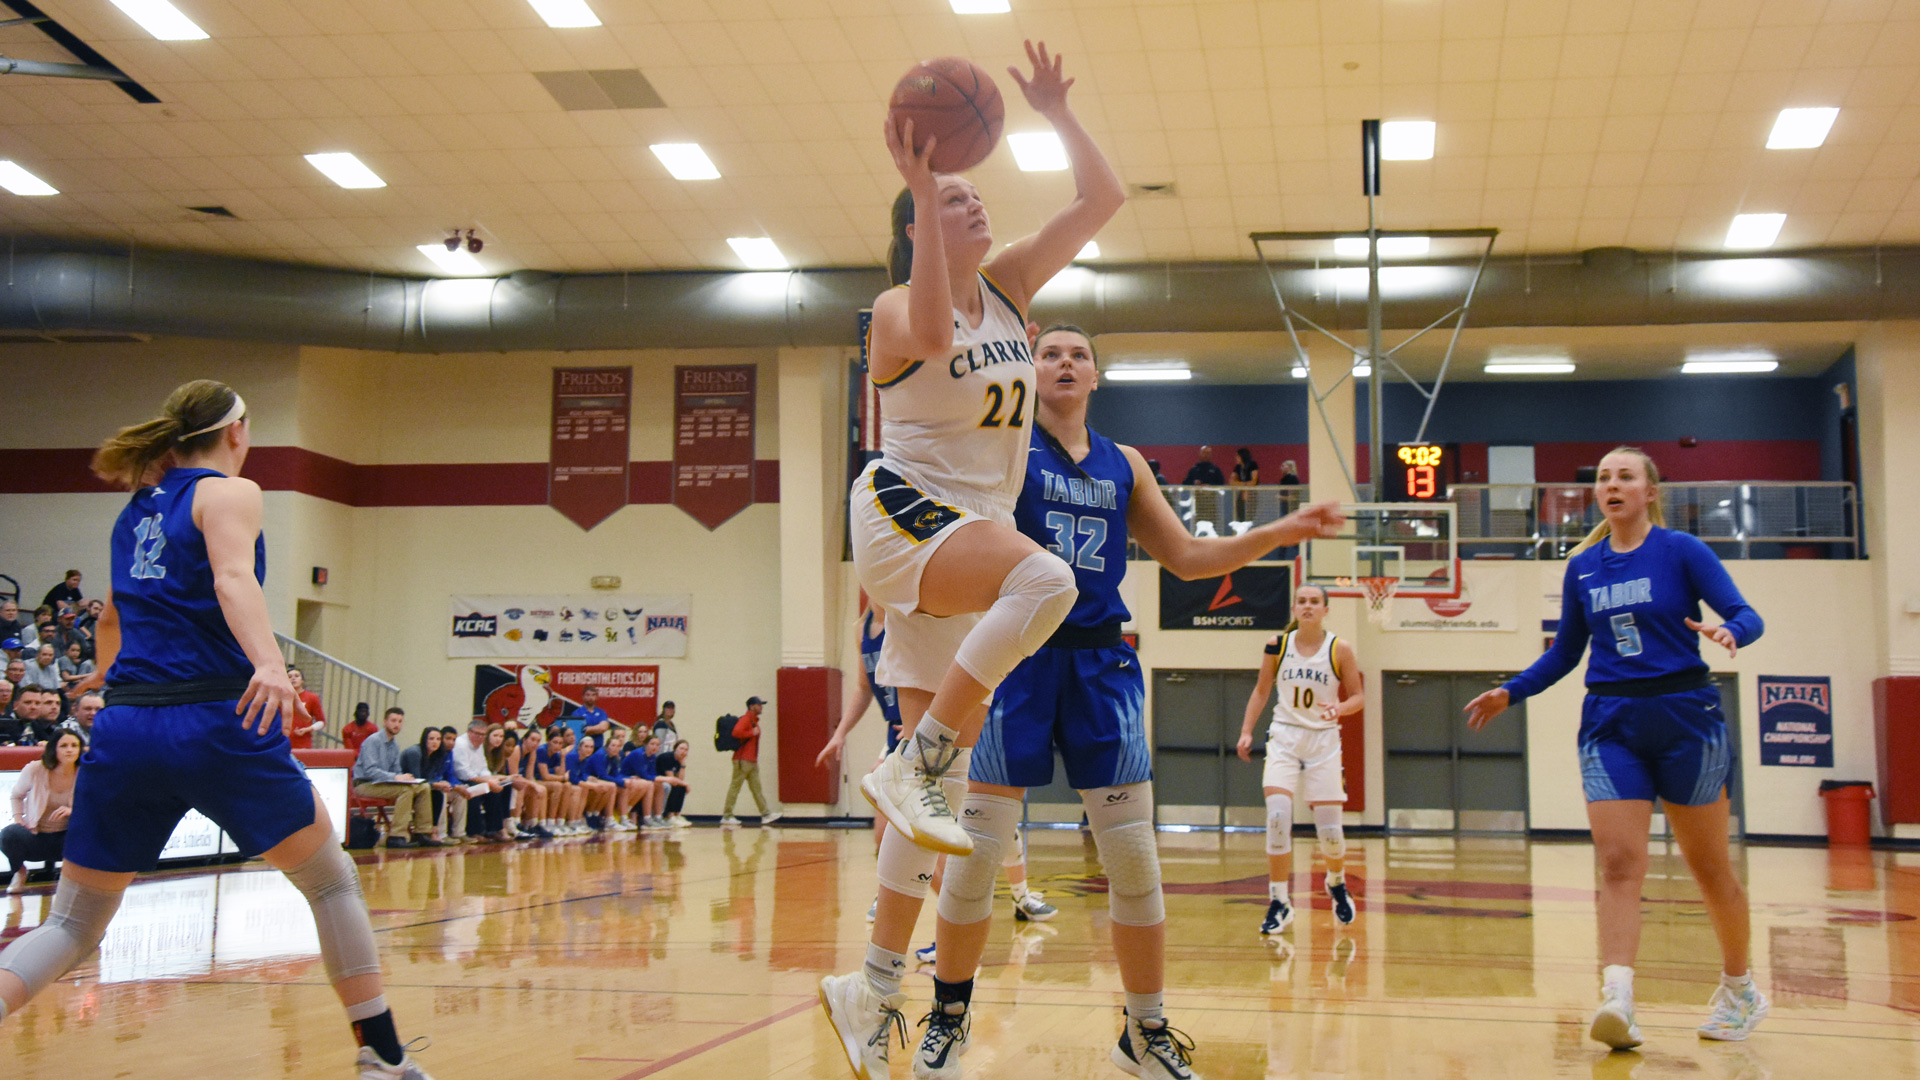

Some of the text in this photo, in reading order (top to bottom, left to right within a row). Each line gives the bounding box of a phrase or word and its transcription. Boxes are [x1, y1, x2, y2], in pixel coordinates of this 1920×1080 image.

[561, 371, 624, 386] FRIENDS
[683, 370, 748, 384] FRIENDS
[976, 377, 1027, 429] 22
[1397, 445, 1442, 466] 9:02
[1041, 468, 1117, 510] TABOR
[1407, 465, 1435, 498] 13
[1046, 510, 1108, 573] 32
[1588, 577, 1653, 613] TABOR
[455, 620, 496, 632] KCAC
[646, 617, 686, 633] NAIA
[1609, 611, 1643, 657] 5
[557, 671, 655, 685] FRIENDSATHLETICS.COM
[1282, 668, 1329, 686] CLARKE
[1293, 686, 1314, 709] 10
[1764, 686, 1826, 707] NAIA
[1776, 721, 1817, 733] NATIONAL
[1763, 732, 1832, 744] CHAMPIONSHIP
